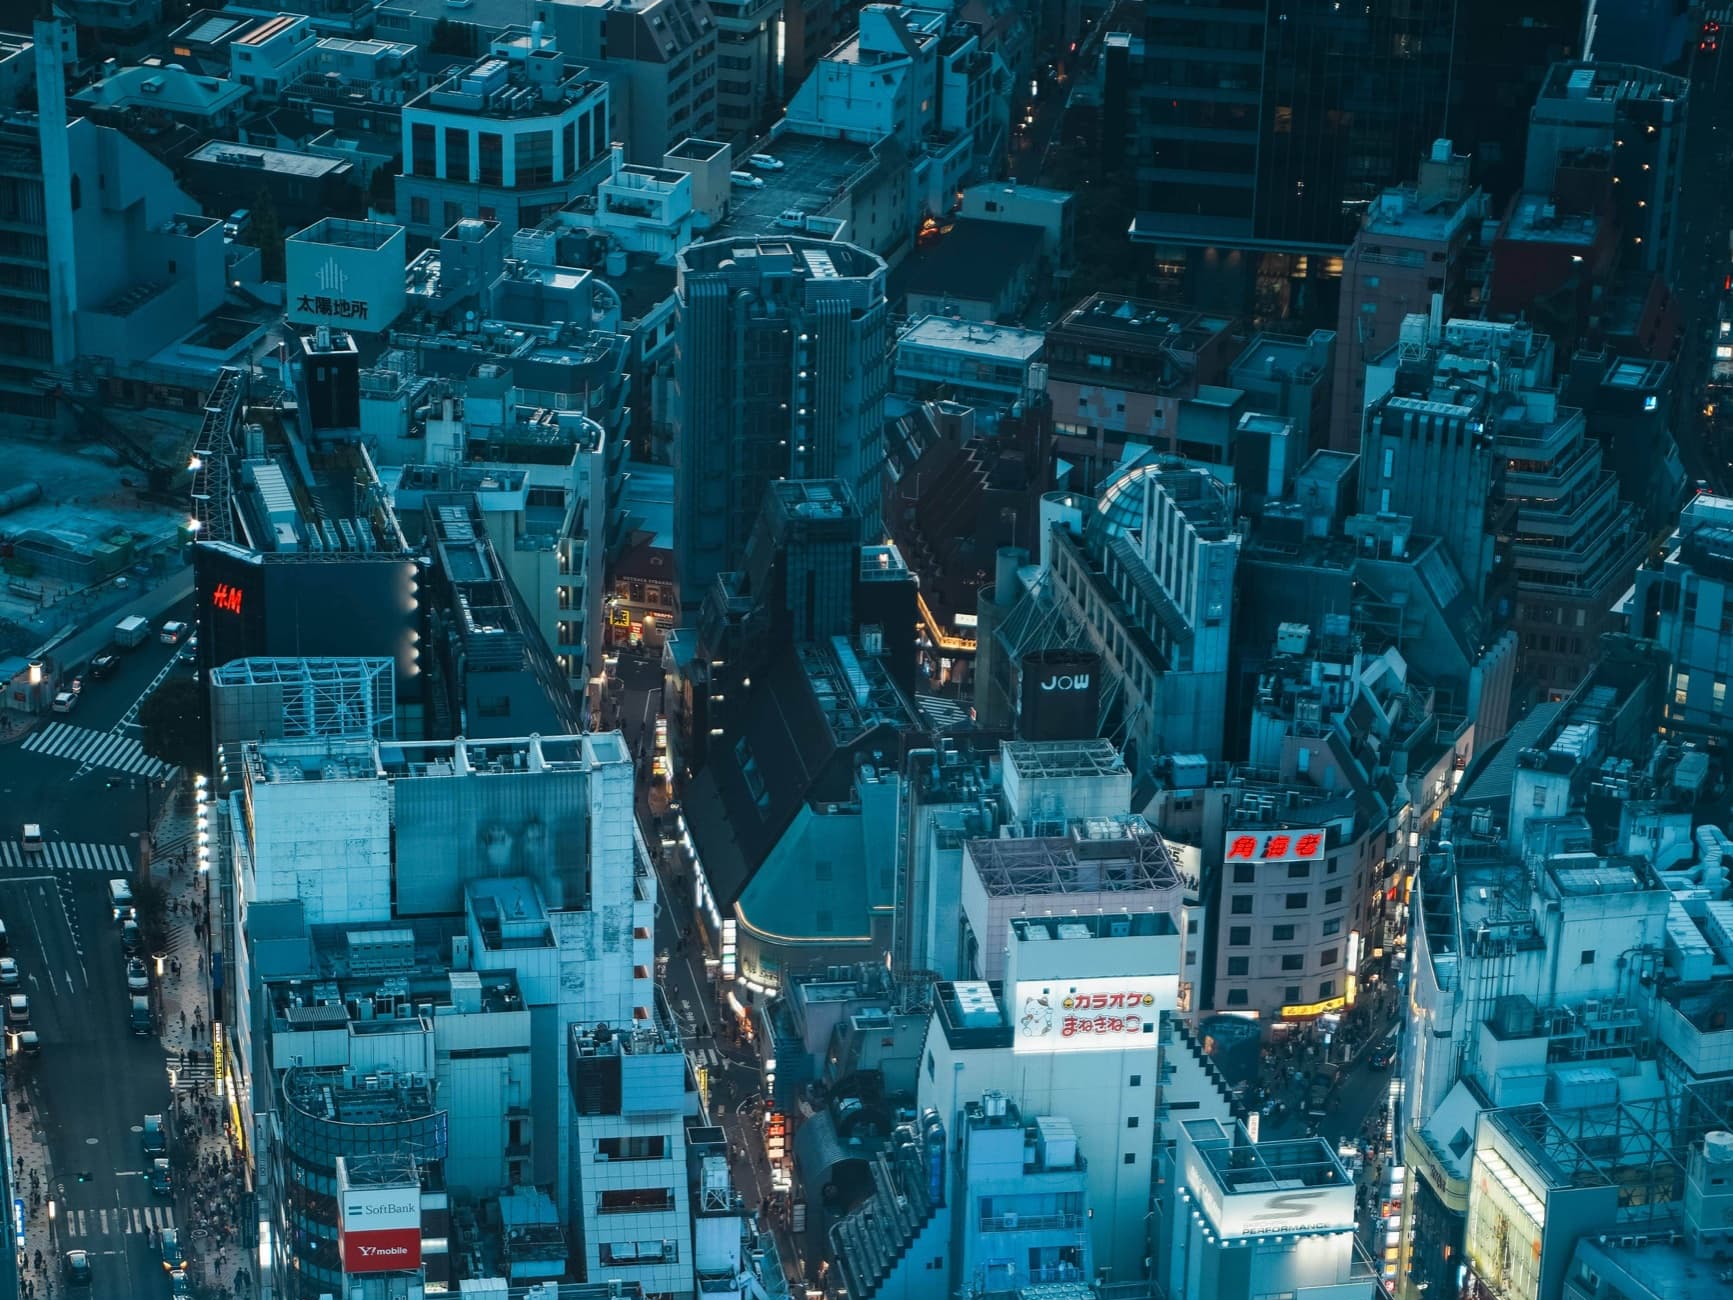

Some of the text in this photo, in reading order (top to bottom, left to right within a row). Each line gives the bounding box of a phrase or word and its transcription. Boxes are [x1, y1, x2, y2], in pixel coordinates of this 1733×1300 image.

[297, 294, 368, 320] 太陽地所
[1041, 674, 1089, 690] JOW
[1074, 992, 1144, 1009] カラオケ
[1061, 1014, 1142, 1038] まねきねこ
[365, 1203, 416, 1216] SoftBank
